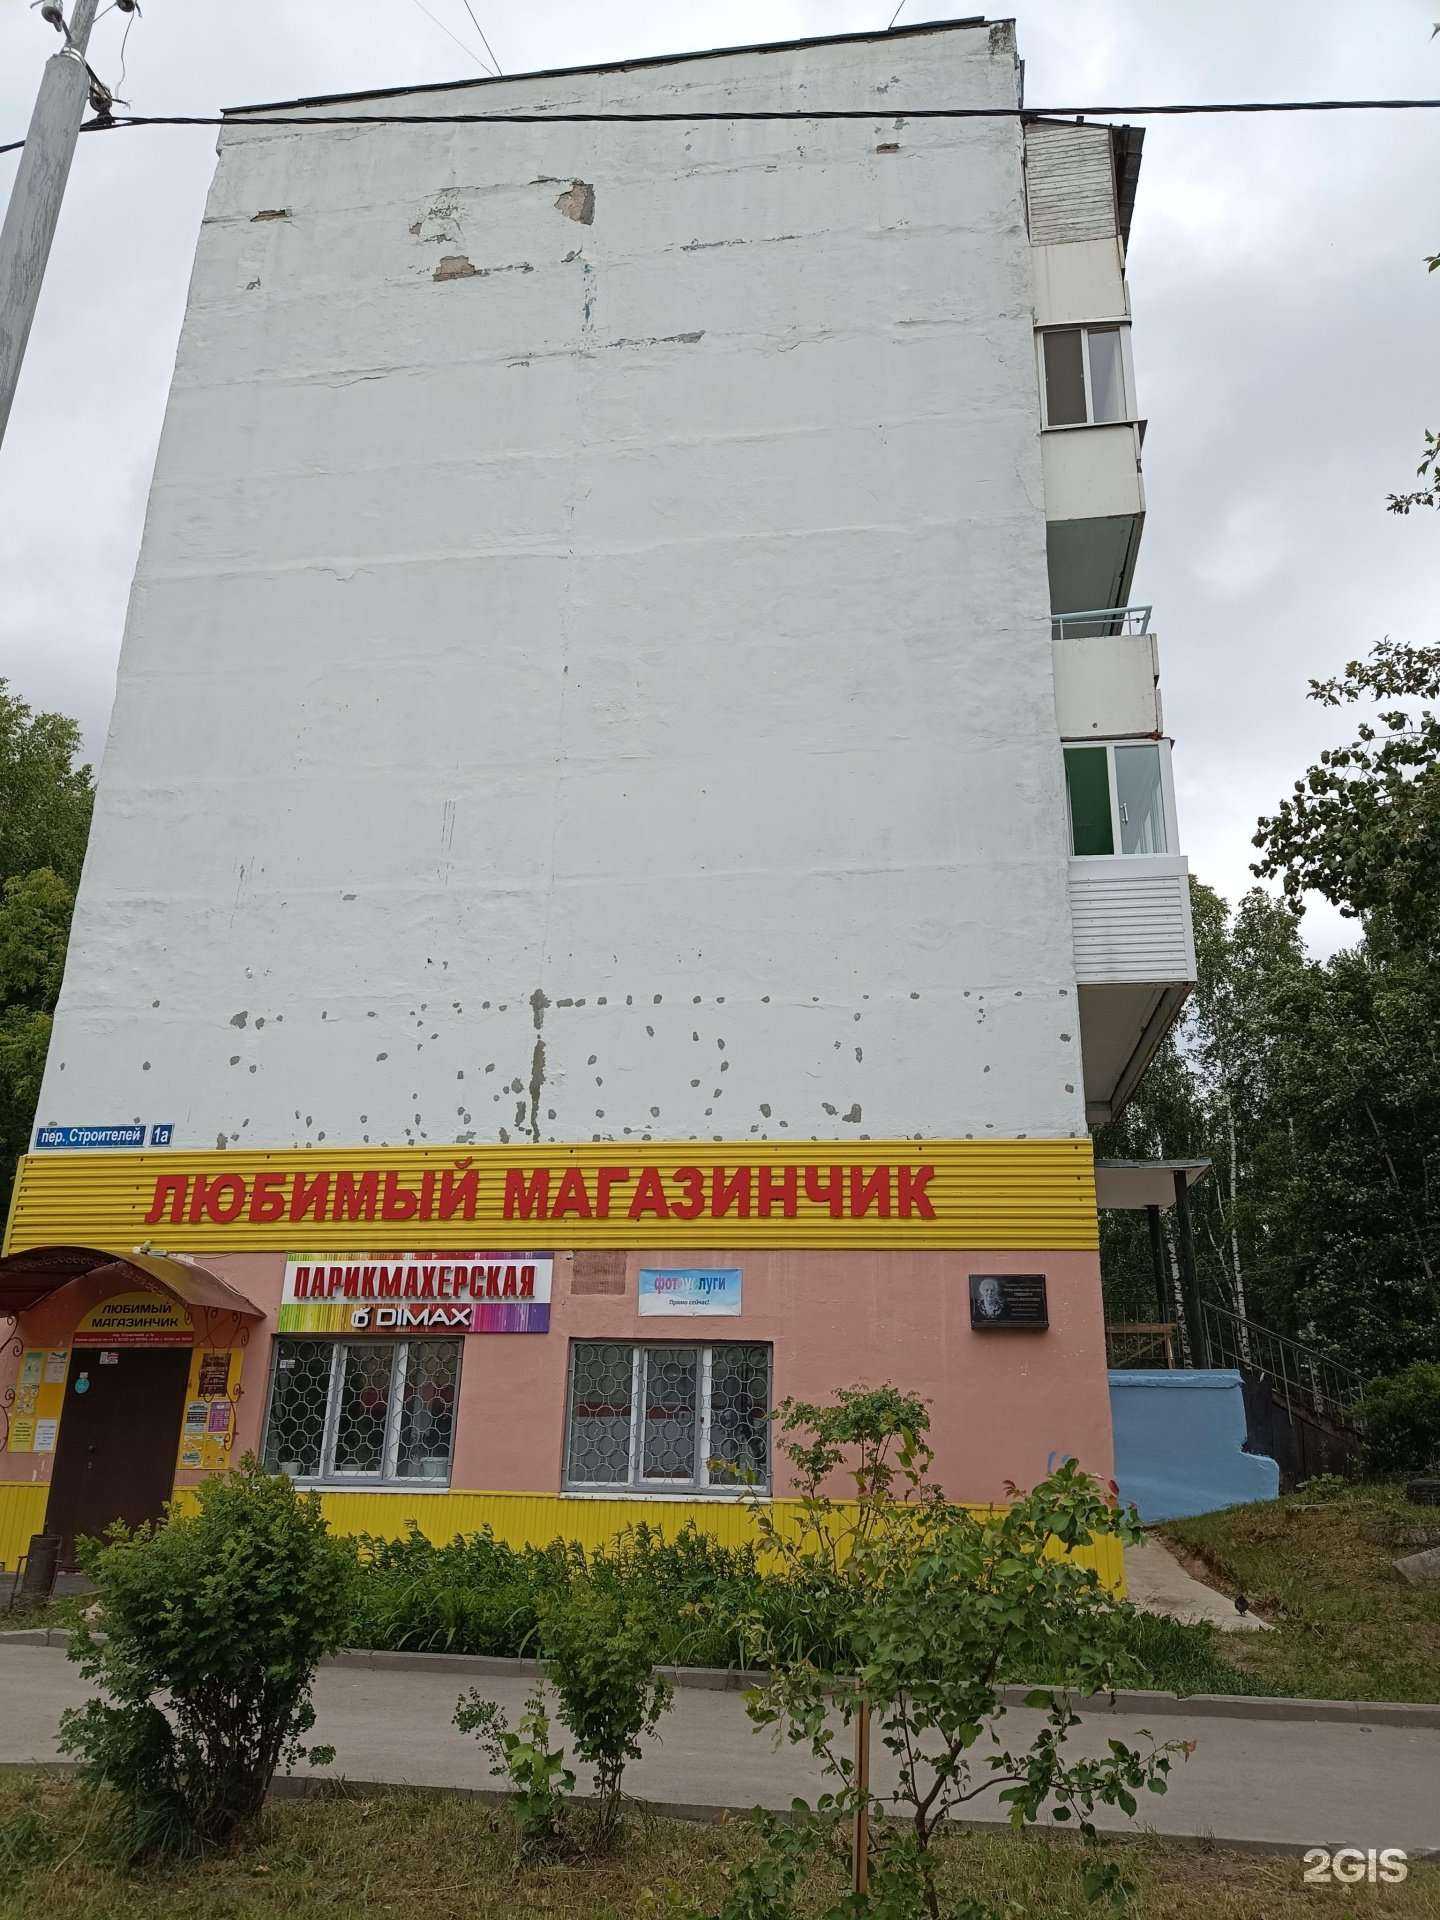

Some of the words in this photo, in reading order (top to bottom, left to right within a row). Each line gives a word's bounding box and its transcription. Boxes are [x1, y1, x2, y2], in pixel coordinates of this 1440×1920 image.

[41, 1130, 66, 1145] пер.
[69, 1127, 141, 1144] Строителей
[154, 1127, 169, 1143] 1а
[144, 1157, 480, 1224] ЛЮБИМЫЙ
[502, 1165, 937, 1222] МАГАЗИНЧИК
[293, 1265, 537, 1298] ПАРИКМАХЕРСКАЯ
[102, 1302, 172, 1314] ЛЮБИМЫЙ
[376, 1307, 471, 1326] DIMAX
[91, 1318, 178, 1328] МАГАЗИНЧИК
